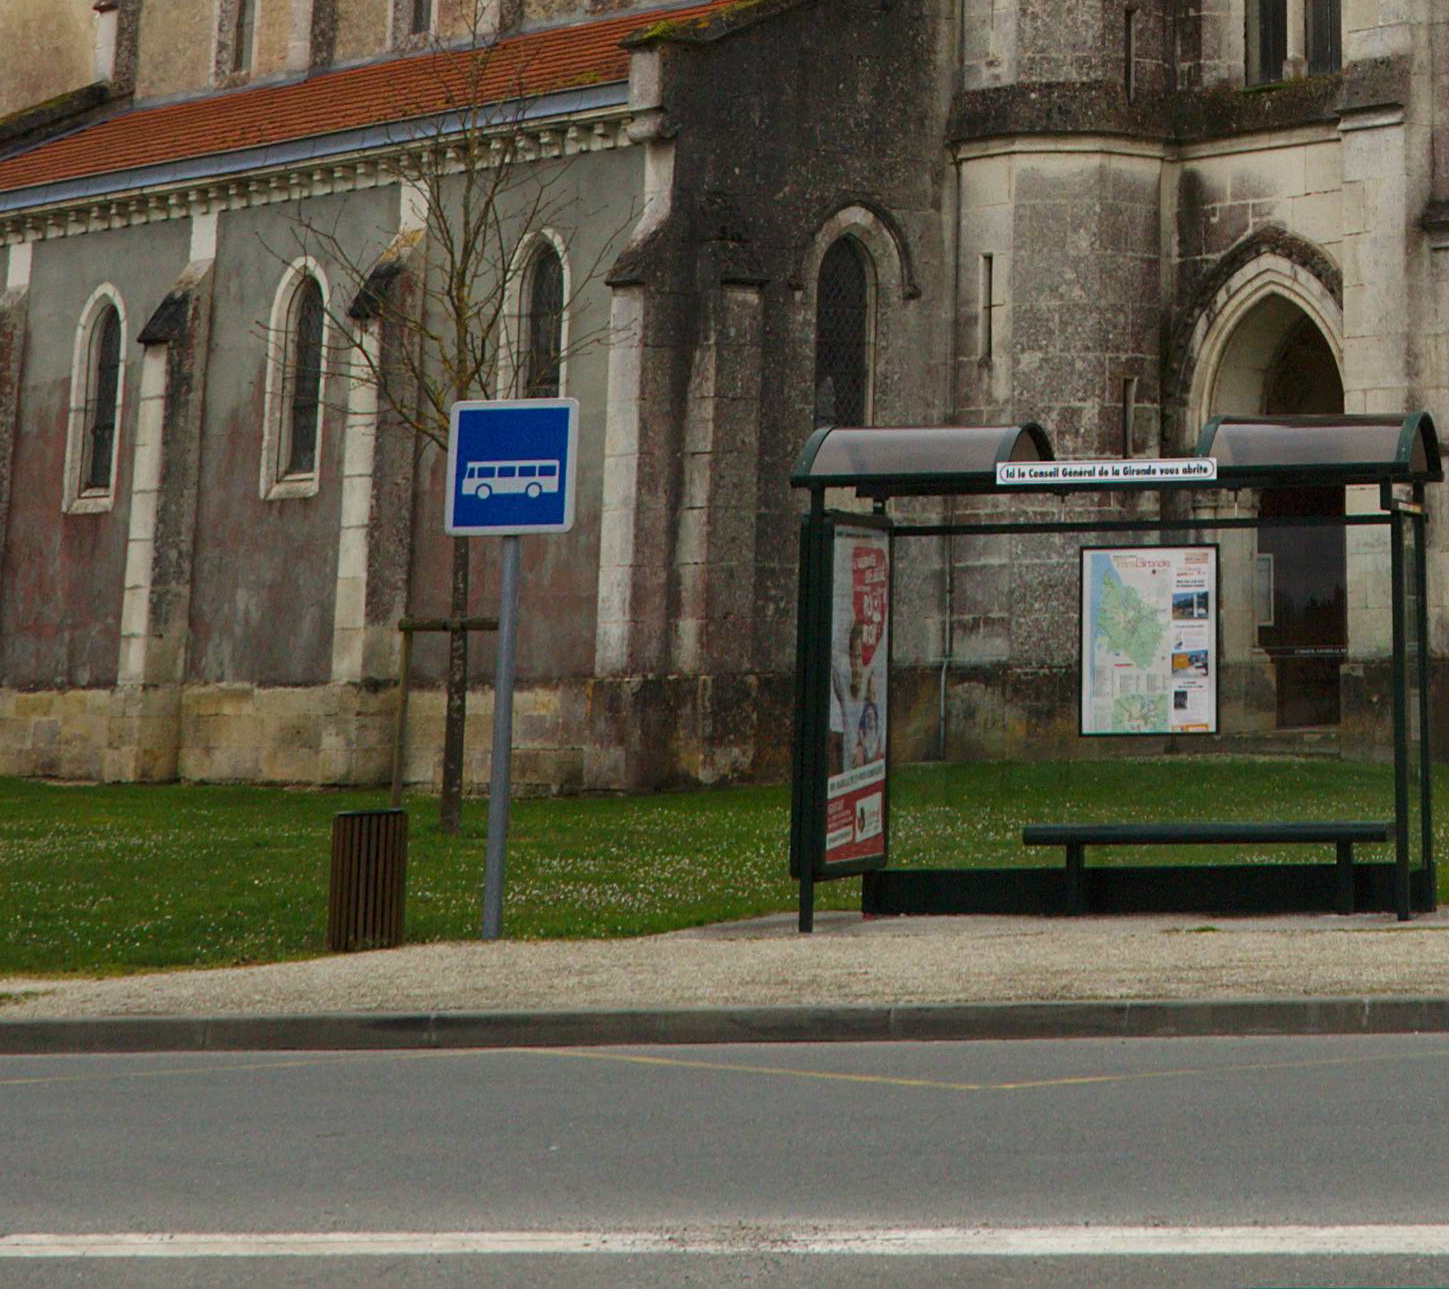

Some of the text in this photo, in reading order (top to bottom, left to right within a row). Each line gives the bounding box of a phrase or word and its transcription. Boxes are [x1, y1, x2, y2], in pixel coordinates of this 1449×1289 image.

[1006, 463, 1208, 478] Ici le Conseil Général de la Gironde vous abrite
